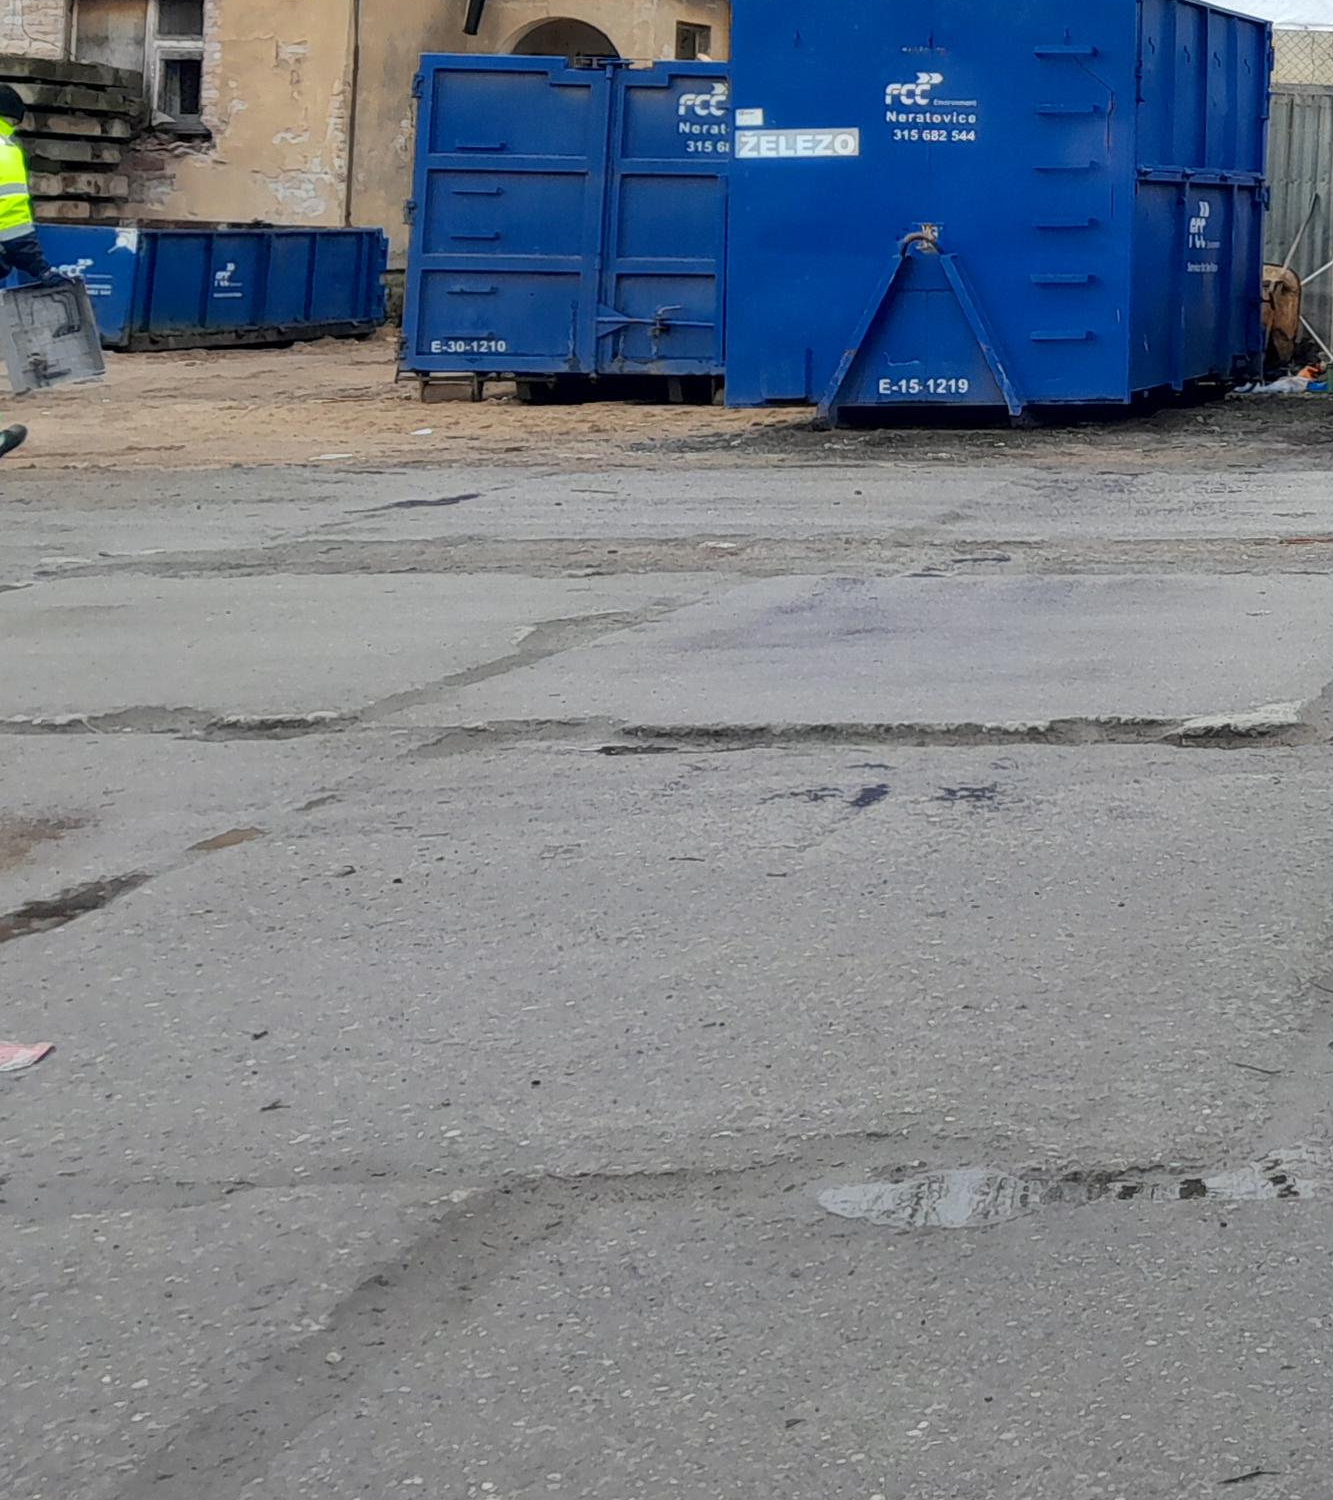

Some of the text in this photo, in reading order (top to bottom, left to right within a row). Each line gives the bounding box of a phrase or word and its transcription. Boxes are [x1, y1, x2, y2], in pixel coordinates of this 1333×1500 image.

[884, 83, 931, 106] FCC
[678, 94, 727, 117] FCC
[886, 110, 977, 124] Neratovice
[679, 122, 730, 134] Nerat
[893, 129, 976, 141] 315 682 544
[686, 141, 713, 153] 315
[738, 131, 857, 157] ŽELEZO
[431, 340, 507, 353] E-30-1210
[878, 378, 969, 394] E-15-1219
